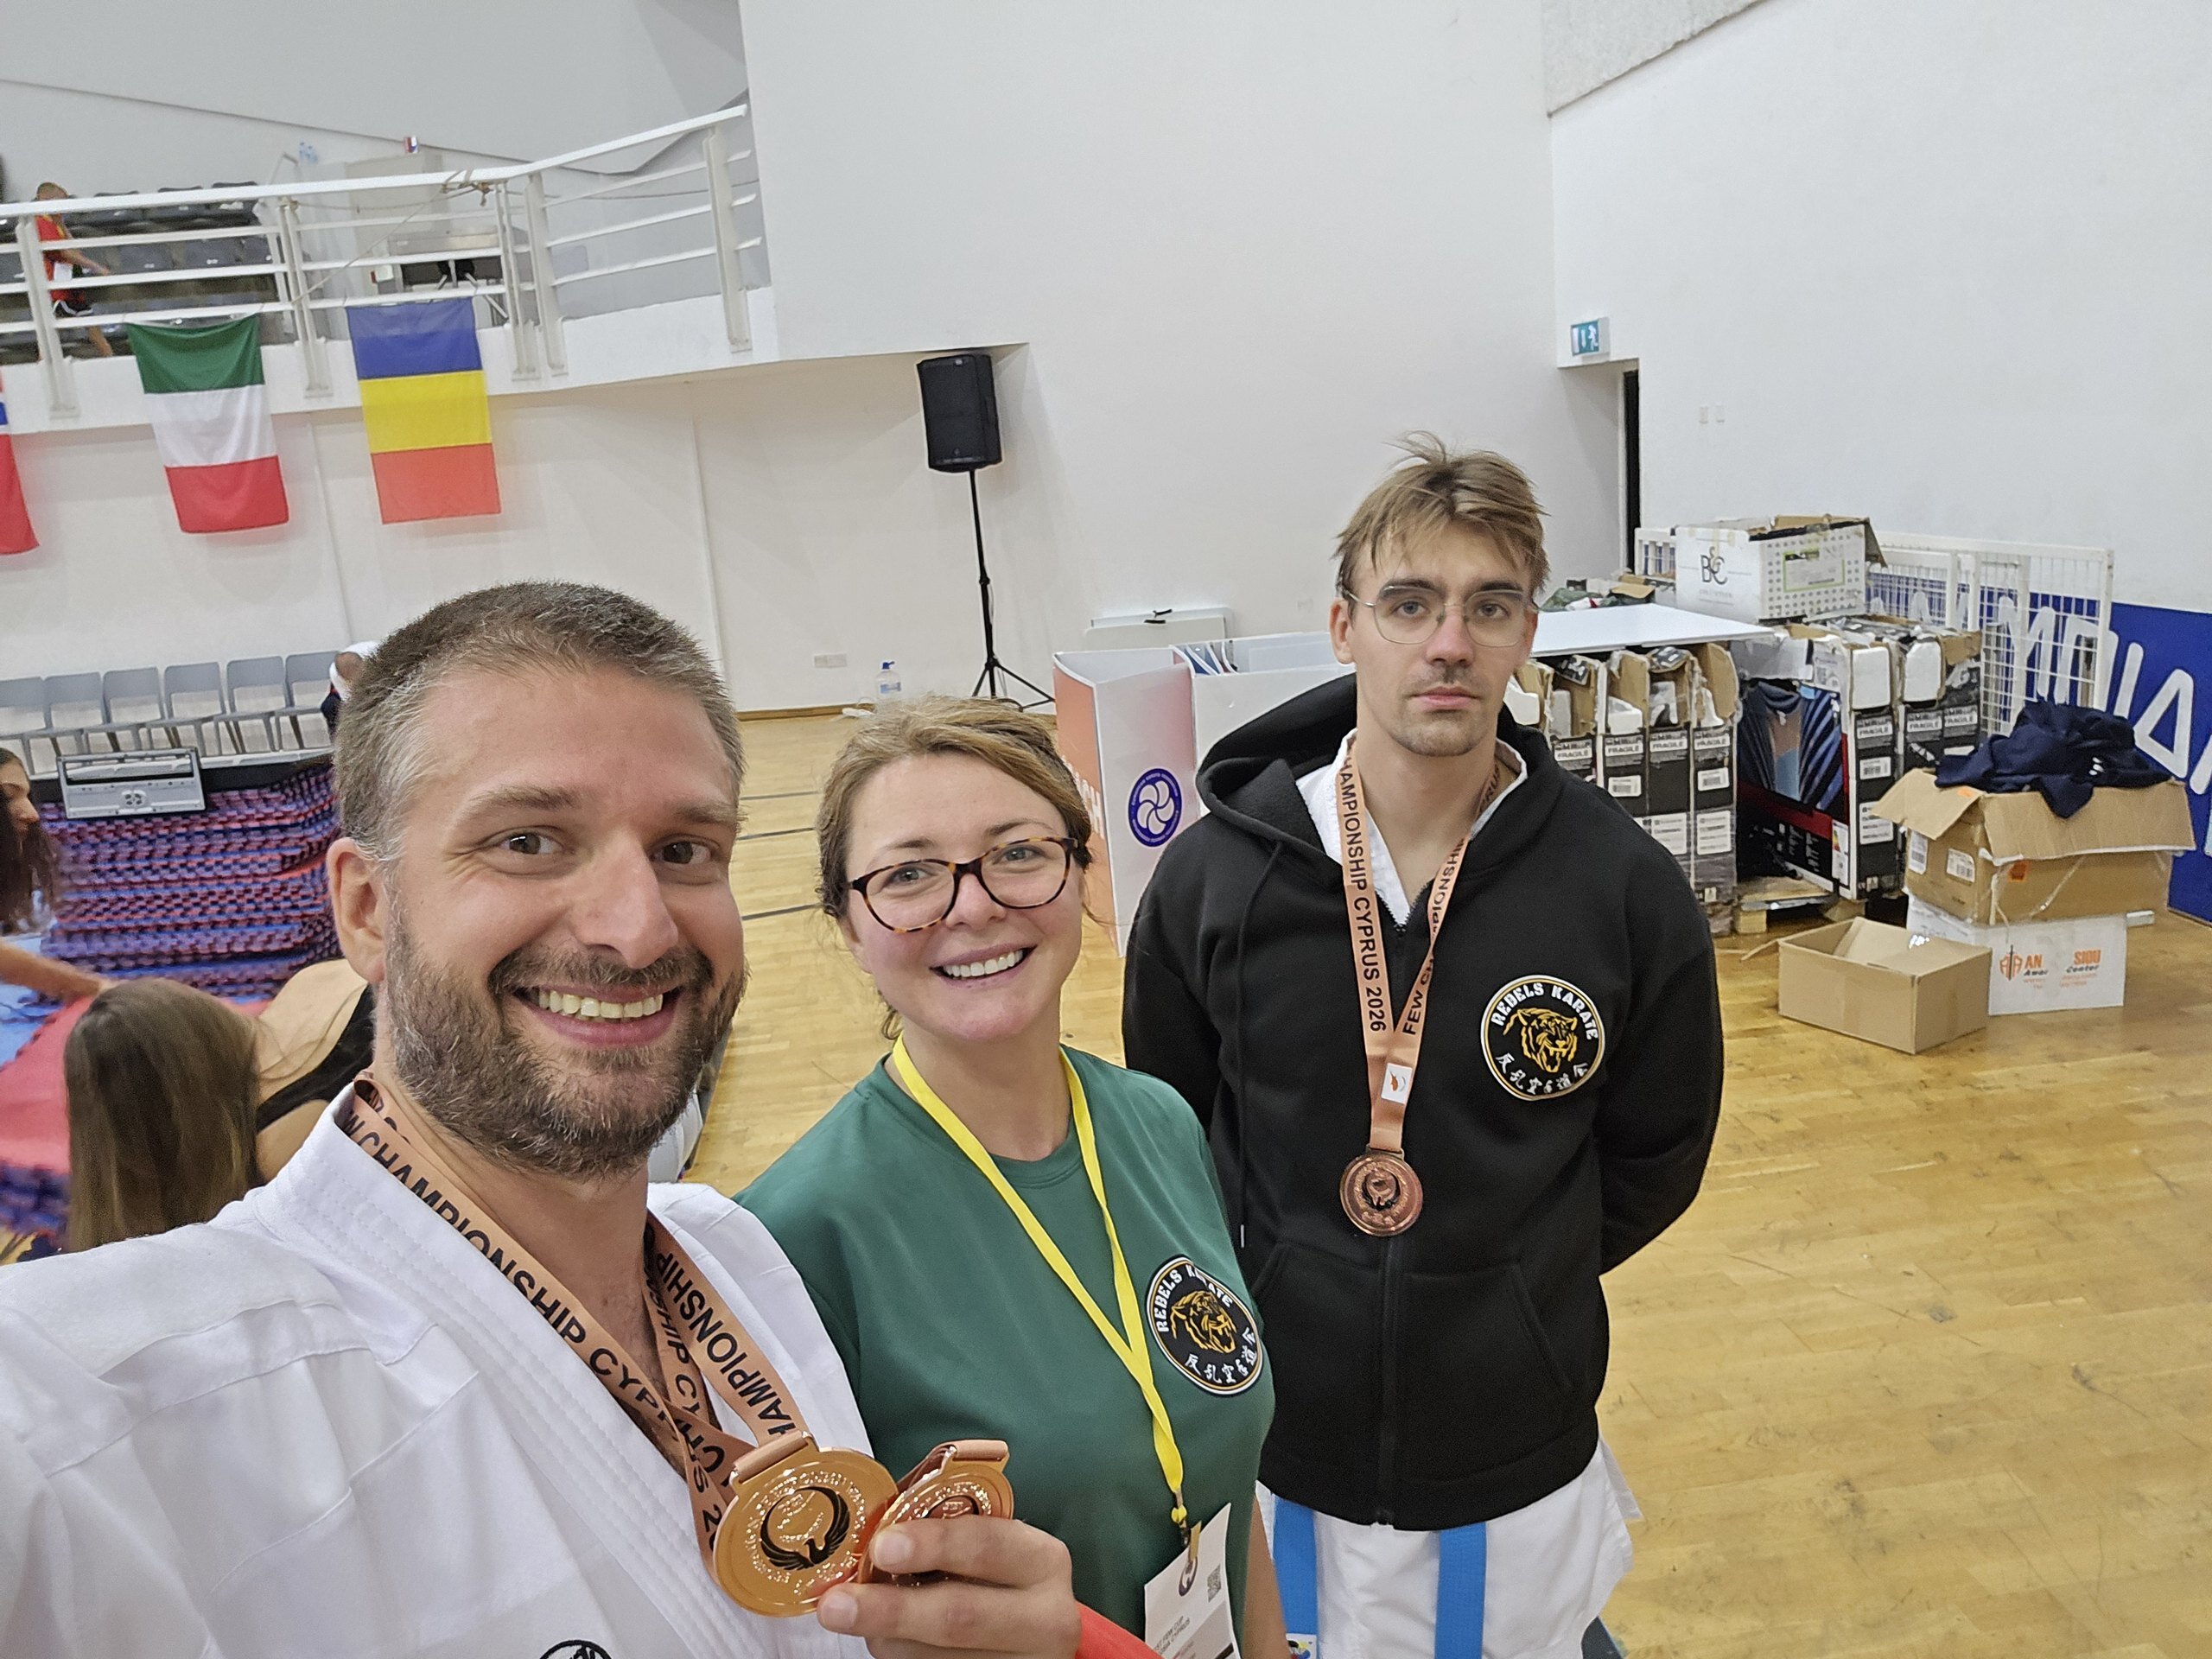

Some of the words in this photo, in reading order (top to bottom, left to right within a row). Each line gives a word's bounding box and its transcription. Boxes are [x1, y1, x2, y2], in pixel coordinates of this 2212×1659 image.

[1557, 749, 1589, 760] FRAGILE
[1608, 745, 1640, 754] FRAGILE
[1652, 741, 1684, 749] FRAGILE
[1696, 738, 1726, 747] FRAGILE
[1340, 757, 1367, 891] HAMPIONSHIP
[1354, 897, 1380, 981] CYPRUS
[2066, 964, 2100, 973] Center
[1365, 985, 1387, 1032] 2026
[1402, 993, 1424, 1036] FEW
[1491, 982, 1545, 1027] REBELS
[1551, 985, 1599, 1039] KARATE
[358, 1131, 587, 1344] CHAMPIONSHIP
[1154, 1268, 1183, 1332] REBELS
[1185, 1264, 1233, 1307] KATE
[655, 1252, 797, 1436] HAMPIONSHIP
